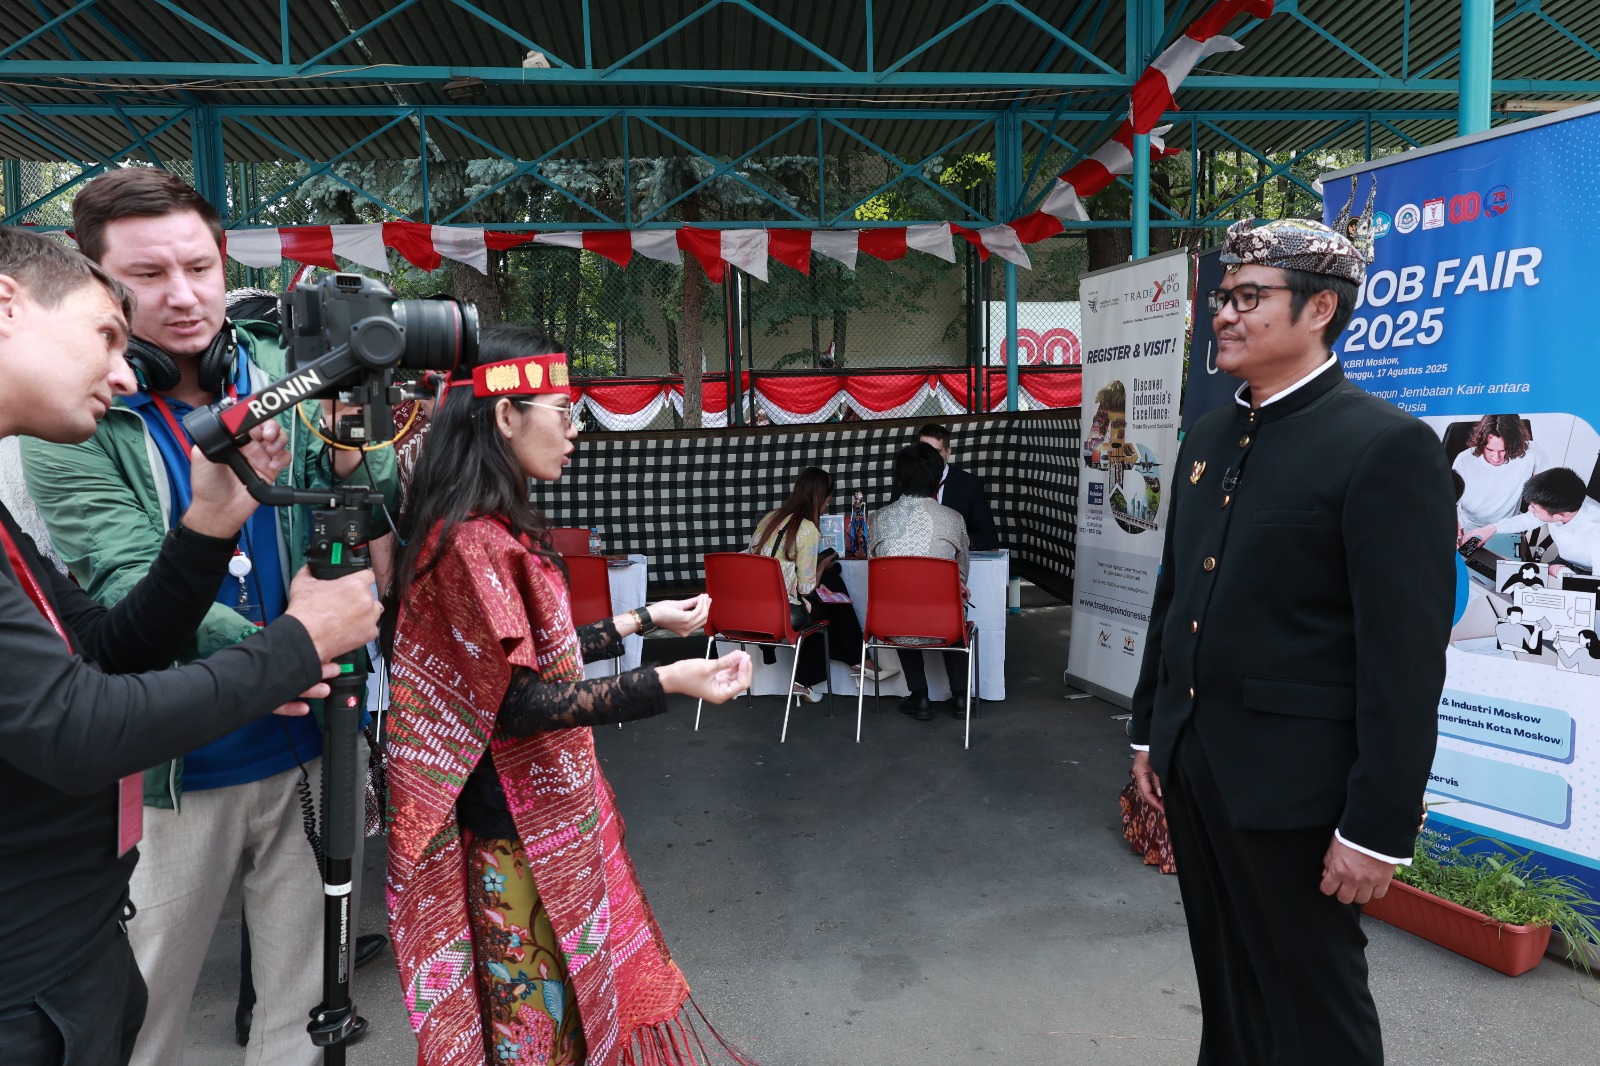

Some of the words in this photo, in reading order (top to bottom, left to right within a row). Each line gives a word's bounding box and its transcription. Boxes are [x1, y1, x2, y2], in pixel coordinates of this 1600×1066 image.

[1432, 246, 1543, 298] FAIR
[1145, 299, 1179, 313] indonesia
[1343, 307, 1445, 353] 2025
[1087, 345, 1131, 364] REGISTER
[1133, 344, 1140, 358] &
[1143, 339, 1171, 356] VISIT
[1343, 359, 1364, 369] KBRI
[1365, 357, 1399, 367] Moskow,
[1343, 370, 1374, 381] Minggu,
[1376, 369, 1387, 378] 17
[1387, 367, 1423, 378] Agustus
[1425, 363, 1448, 374] 2025
[247, 368, 321, 419] RONIN
[1133, 378, 1163, 391] Discover
[1400, 385, 1453, 398] Jembatan
[1457, 382, 1486, 395] Karir
[1488, 382, 1530, 393] antara
[1132, 391, 1171, 405] Indonesia's
[1132, 406, 1170, 420] Excellence:
[1441, 697, 1450, 706] &
[1451, 699, 1492, 715] Industri
[1493, 707, 1541, 724] Moskow
[1486, 722, 1512, 735] Kota
[1513, 727, 1563, 748] Moskow)
[1428, 772, 1459, 787] Servis
[340, 896, 348, 945] Manfrotto
